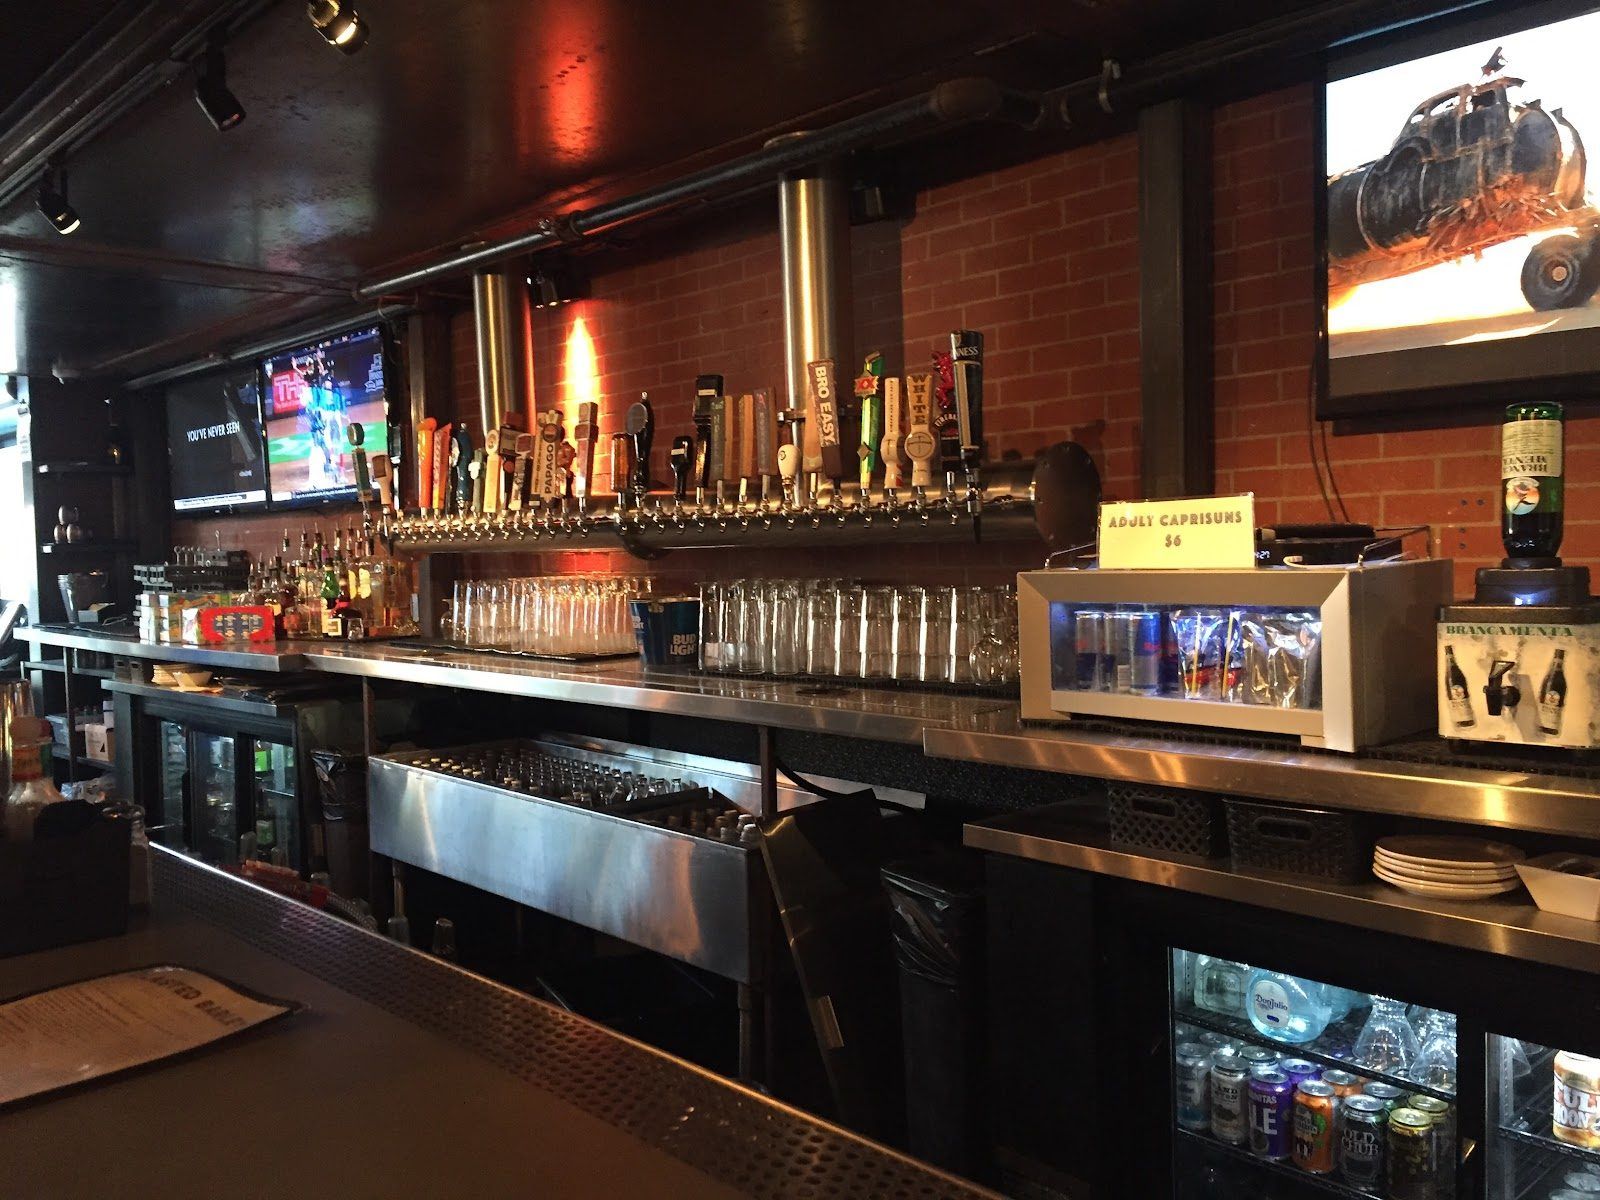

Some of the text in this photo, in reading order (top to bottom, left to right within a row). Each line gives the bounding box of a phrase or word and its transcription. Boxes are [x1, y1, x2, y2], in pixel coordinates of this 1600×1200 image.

[814, 366, 830, 398] BRO
[911, 374, 928, 424] WHITE
[186, 421, 240, 442] YOU'VE NEVER SEEN
[819, 401, 836, 445] EASY
[544, 443, 554, 494] PAPAGO
[1159, 511, 1242, 526] CAPRISUNS
[1165, 534, 1181, 548] $6
[673, 633, 697, 645] BUD
[1446, 625, 1574, 636] BRANCAMENTA
[670, 643, 697, 656] LIGH
[1343, 1128, 1375, 1145] OLD
[1341, 1136, 1379, 1156] CHUB
